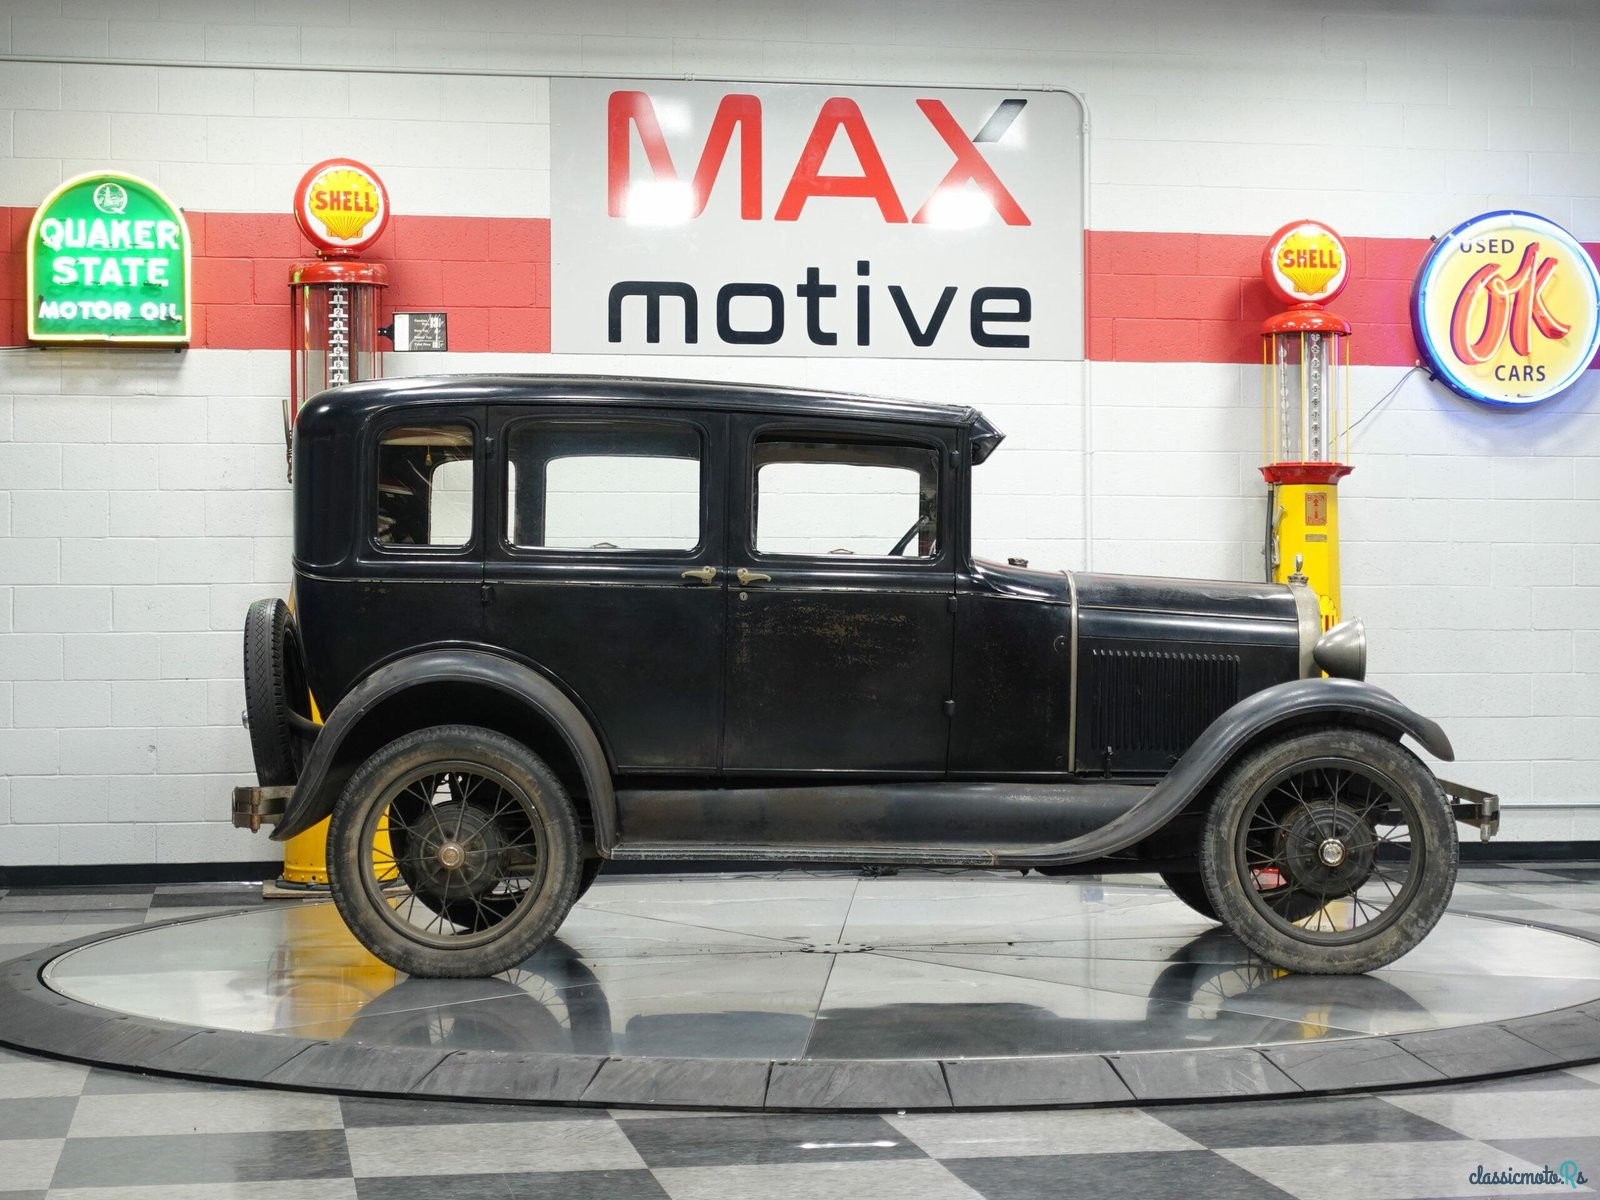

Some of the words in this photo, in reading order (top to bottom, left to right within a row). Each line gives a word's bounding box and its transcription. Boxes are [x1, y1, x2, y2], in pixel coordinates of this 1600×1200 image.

[608, 90, 1032, 226] MAX
[315, 190, 374, 212] SHELL
[40, 217, 180, 252] QUAKER
[1460, 239, 1515, 254] USED
[52, 256, 169, 287] STATE
[1283, 249, 1338, 269] SHELL
[38, 300, 132, 320] MOTOR
[140, 301, 183, 321] OIL
[608, 260, 1032, 349] motive
[1450, 242, 1571, 365] OK
[1494, 365, 1546, 382] CARS
